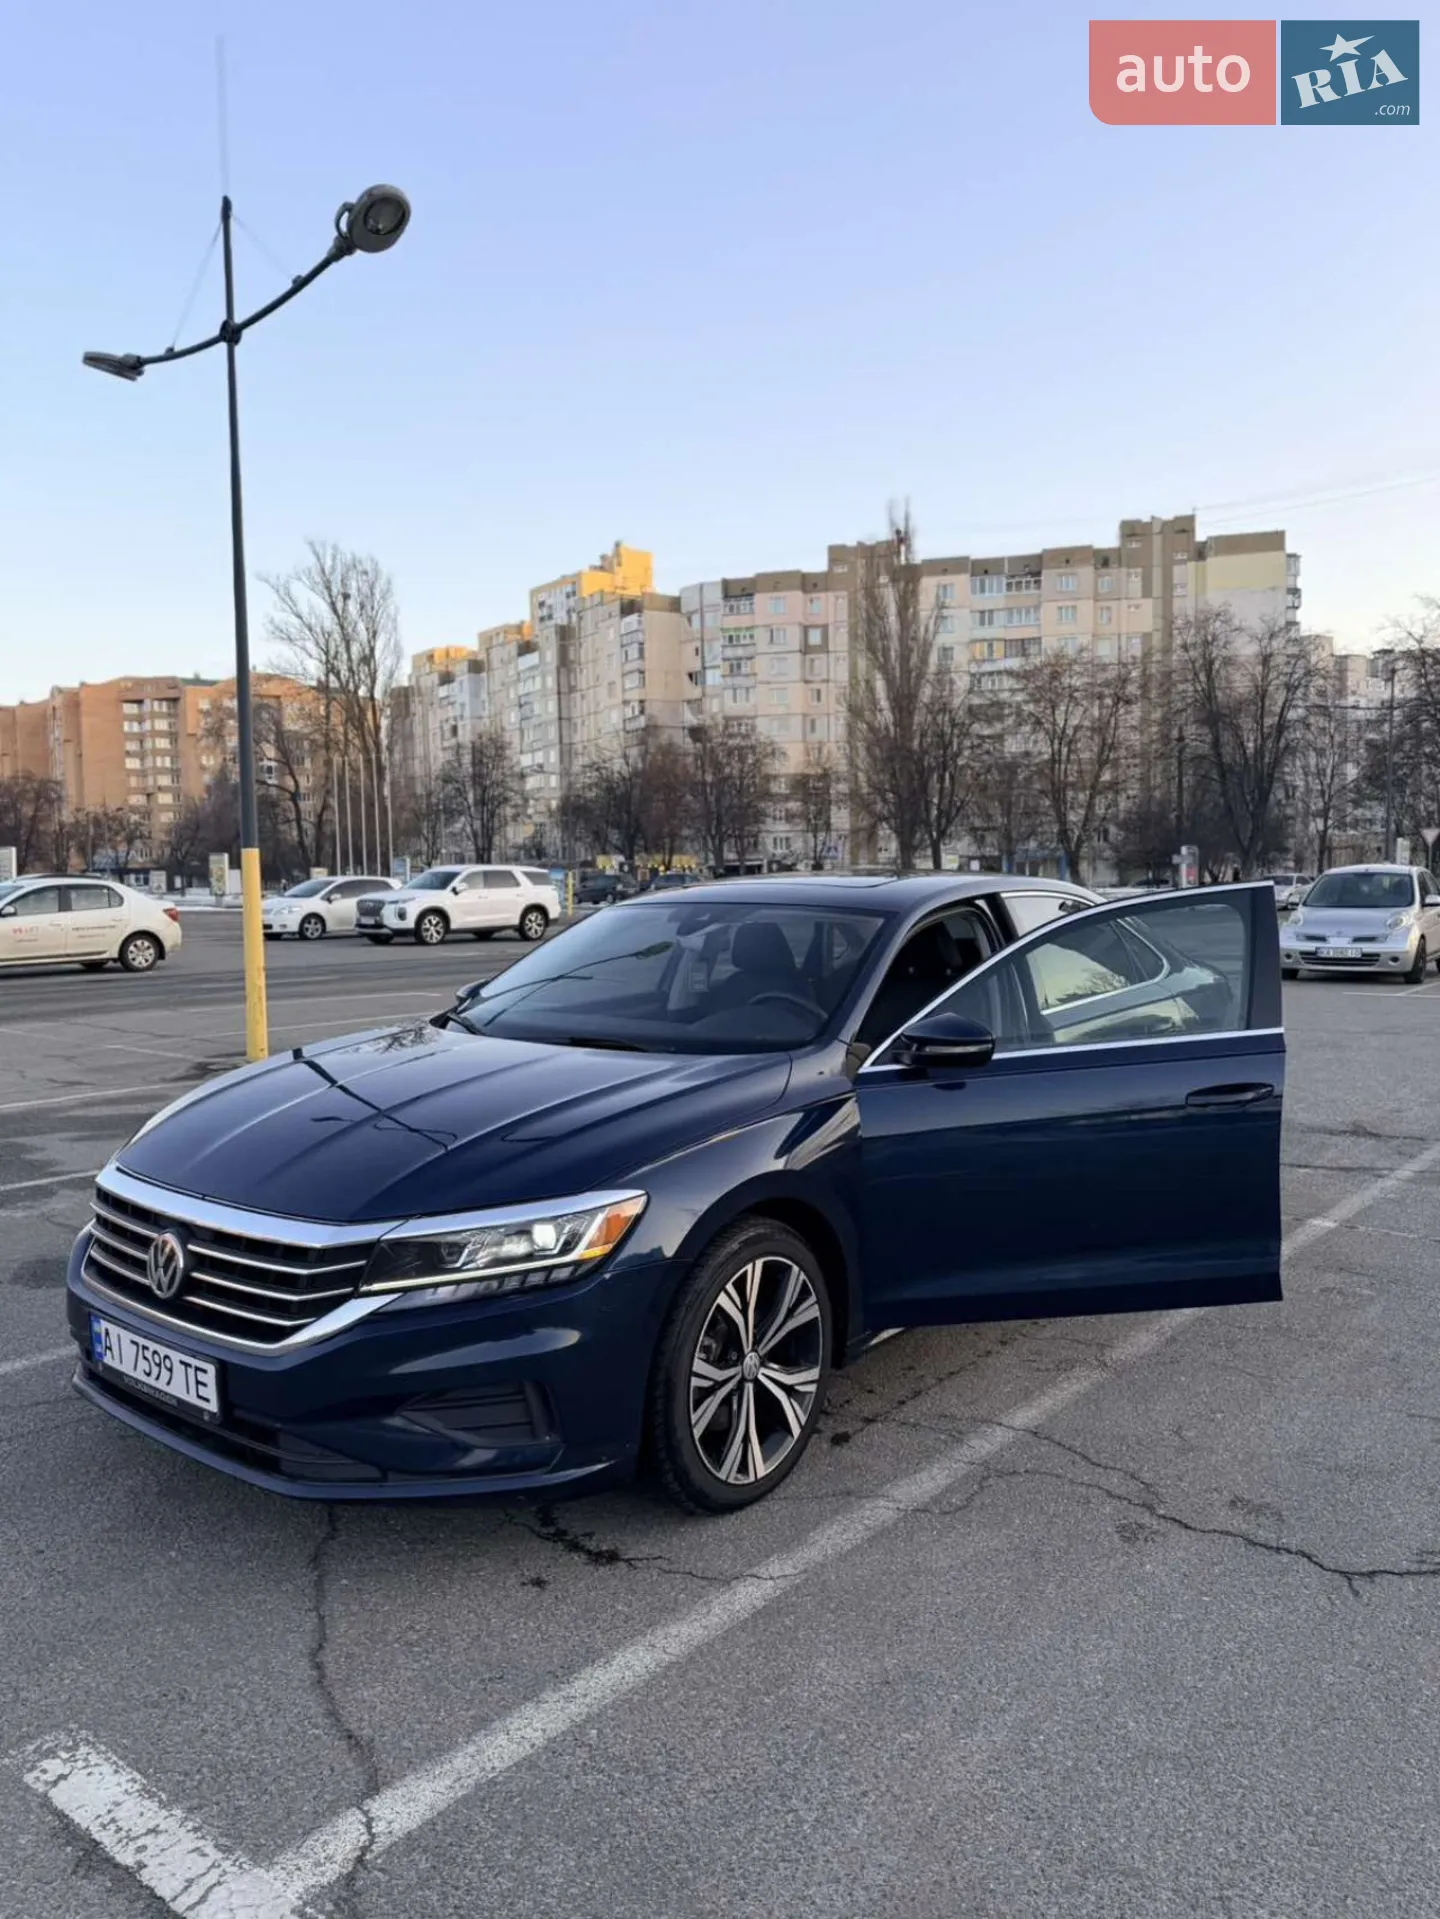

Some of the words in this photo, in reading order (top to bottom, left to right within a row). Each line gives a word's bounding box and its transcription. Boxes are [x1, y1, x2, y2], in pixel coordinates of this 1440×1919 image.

[104, 1328, 123, 1365] AI
[130, 1339, 174, 1387] 7599
[179, 1359, 211, 1404] TE
